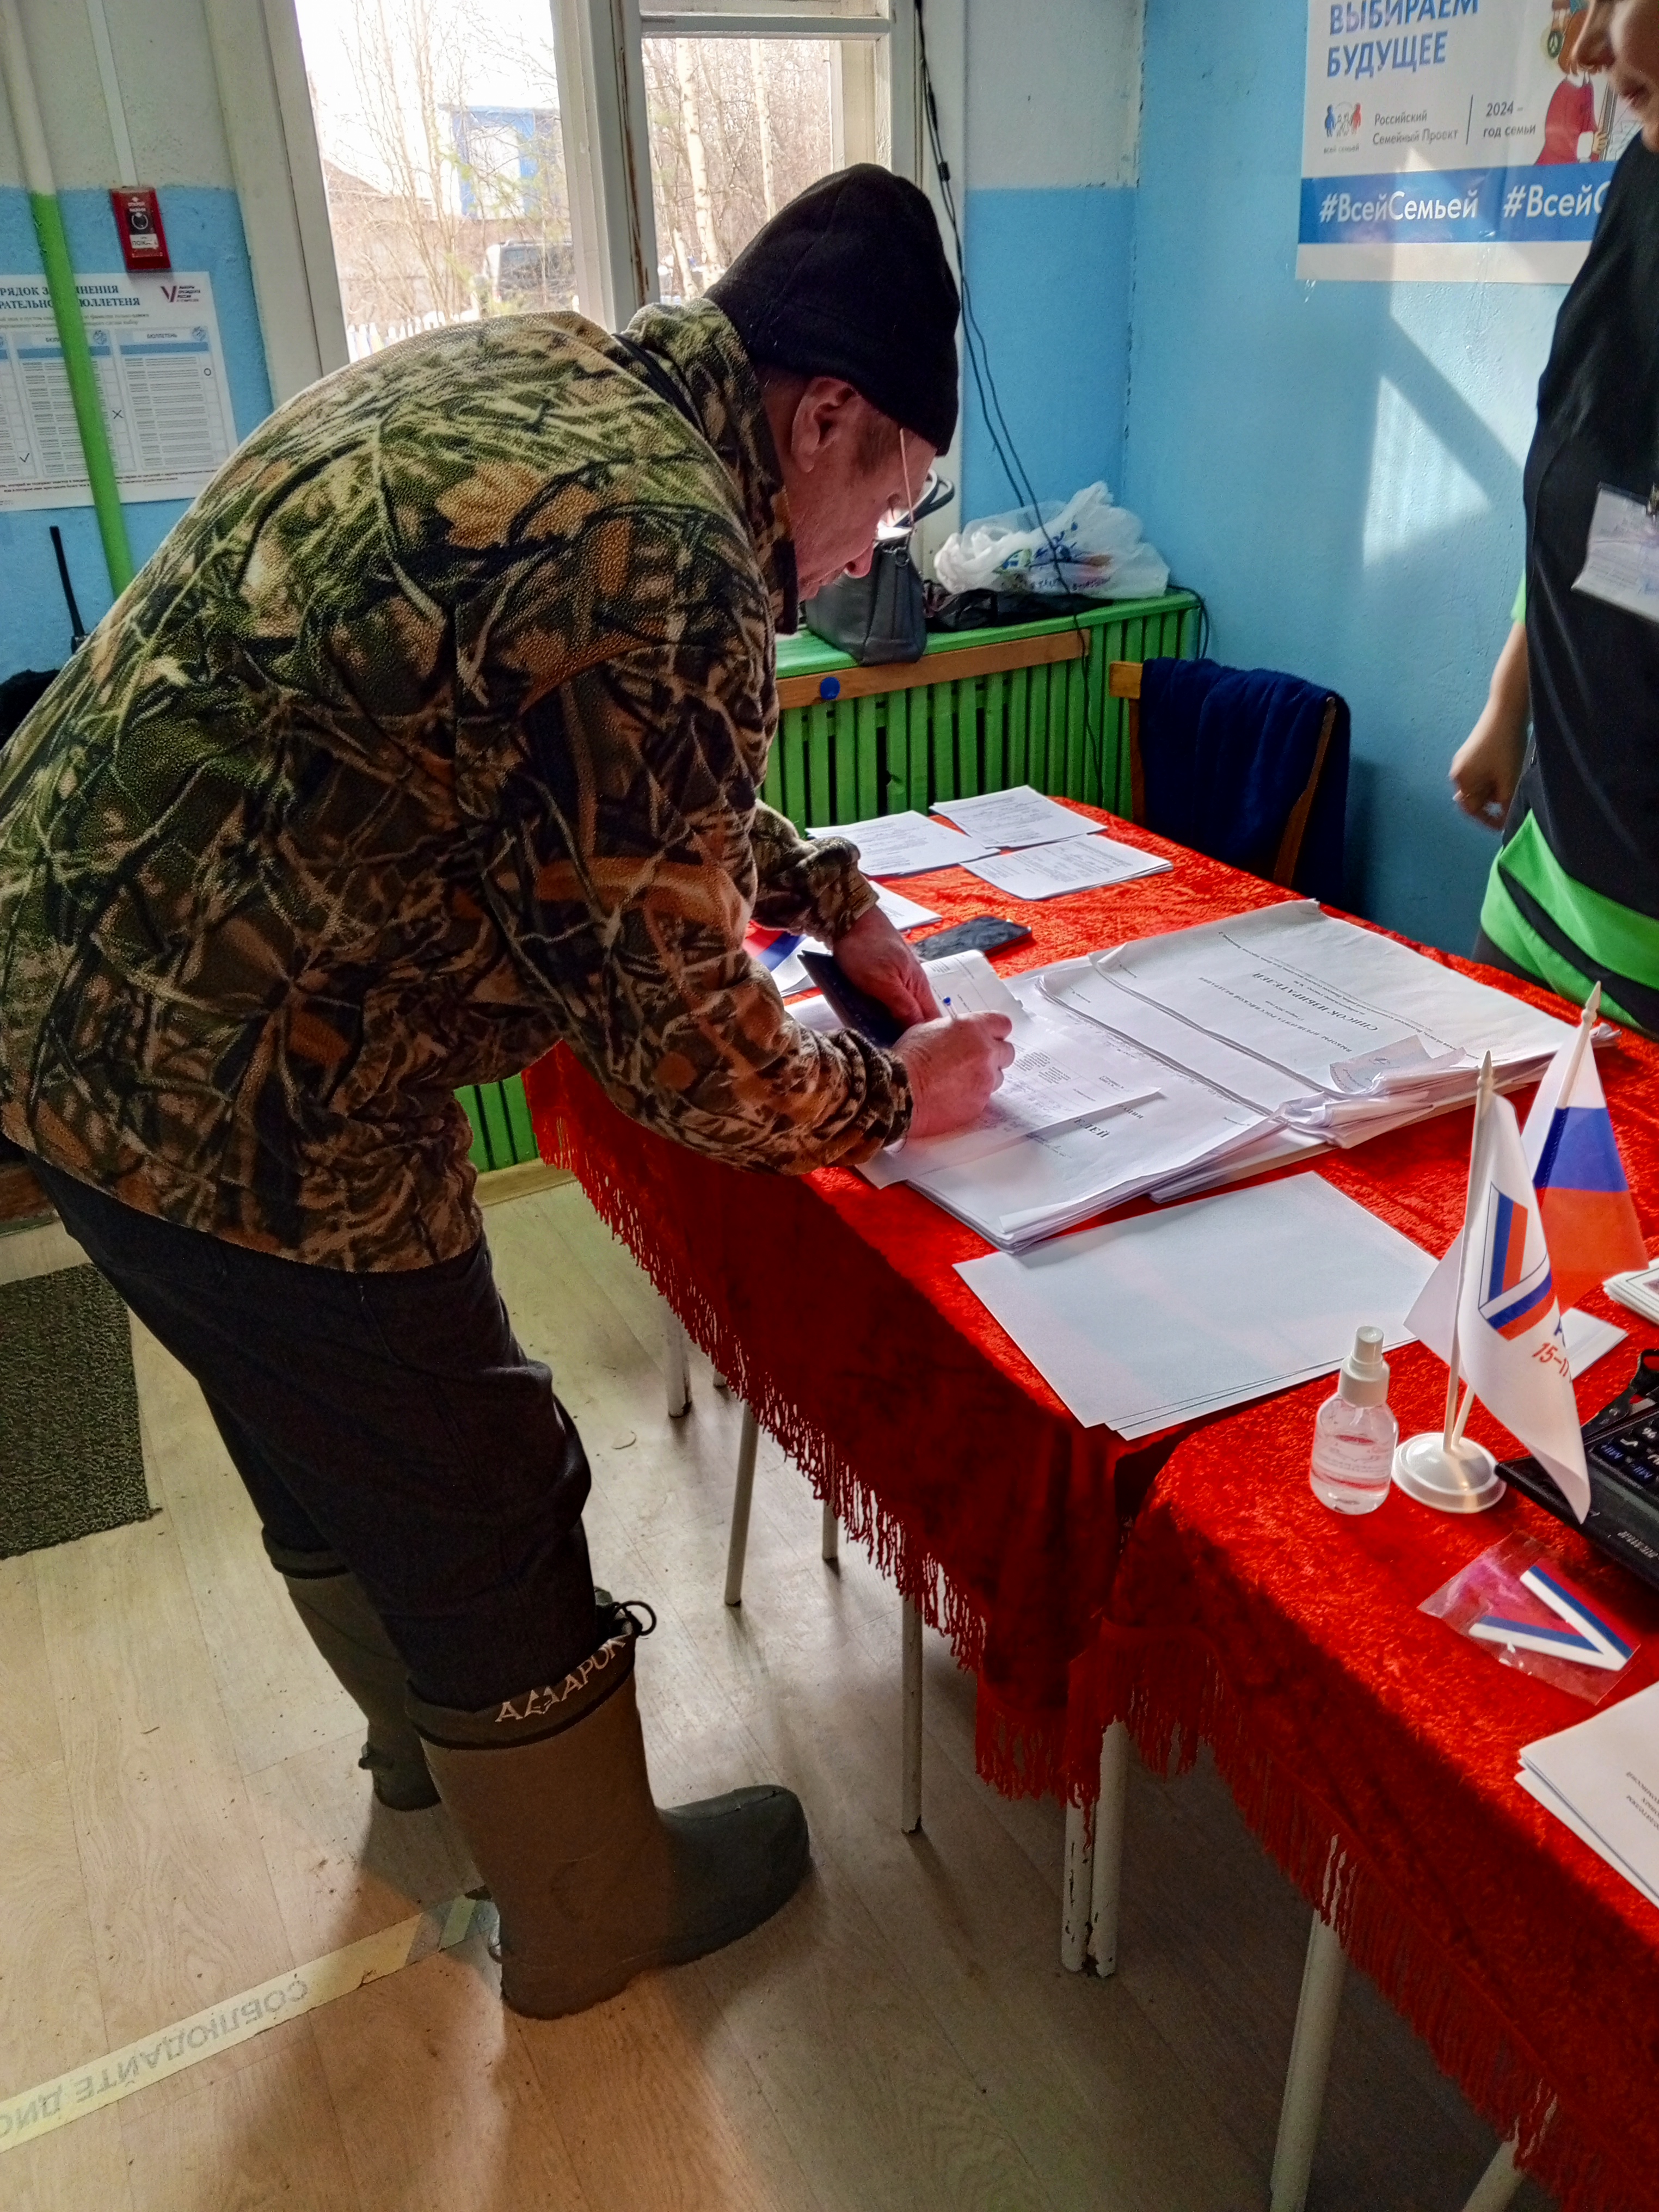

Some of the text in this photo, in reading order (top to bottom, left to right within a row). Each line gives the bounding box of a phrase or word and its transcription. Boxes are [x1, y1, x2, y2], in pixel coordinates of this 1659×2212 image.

[1330, 0, 1478, 35] ВЫБИРАЕМ
[1327, 30, 1448, 81] БУДУЩЕЕ
[1374, 109, 1428, 126] Российский
[1486, 101, 1514, 118] 2024
[1372, 127, 1459, 145] Семейный Проект
[1483, 124, 1536, 139] год семьи
[1319, 189, 1479, 223] #ВсейСемьей
[78, 297, 140, 308] ЮЛЛЕТЕНЯ
[1252, 972, 1329, 1011] ИЗБИРАТЕЛЕЙ
[1327, 1010, 1378, 1031] СПИСОК
[1074, 1117, 1110, 1138] ЕЛЕЙ
[75, 1979, 309, 2104] СОБЛЮДАЙТЕ
